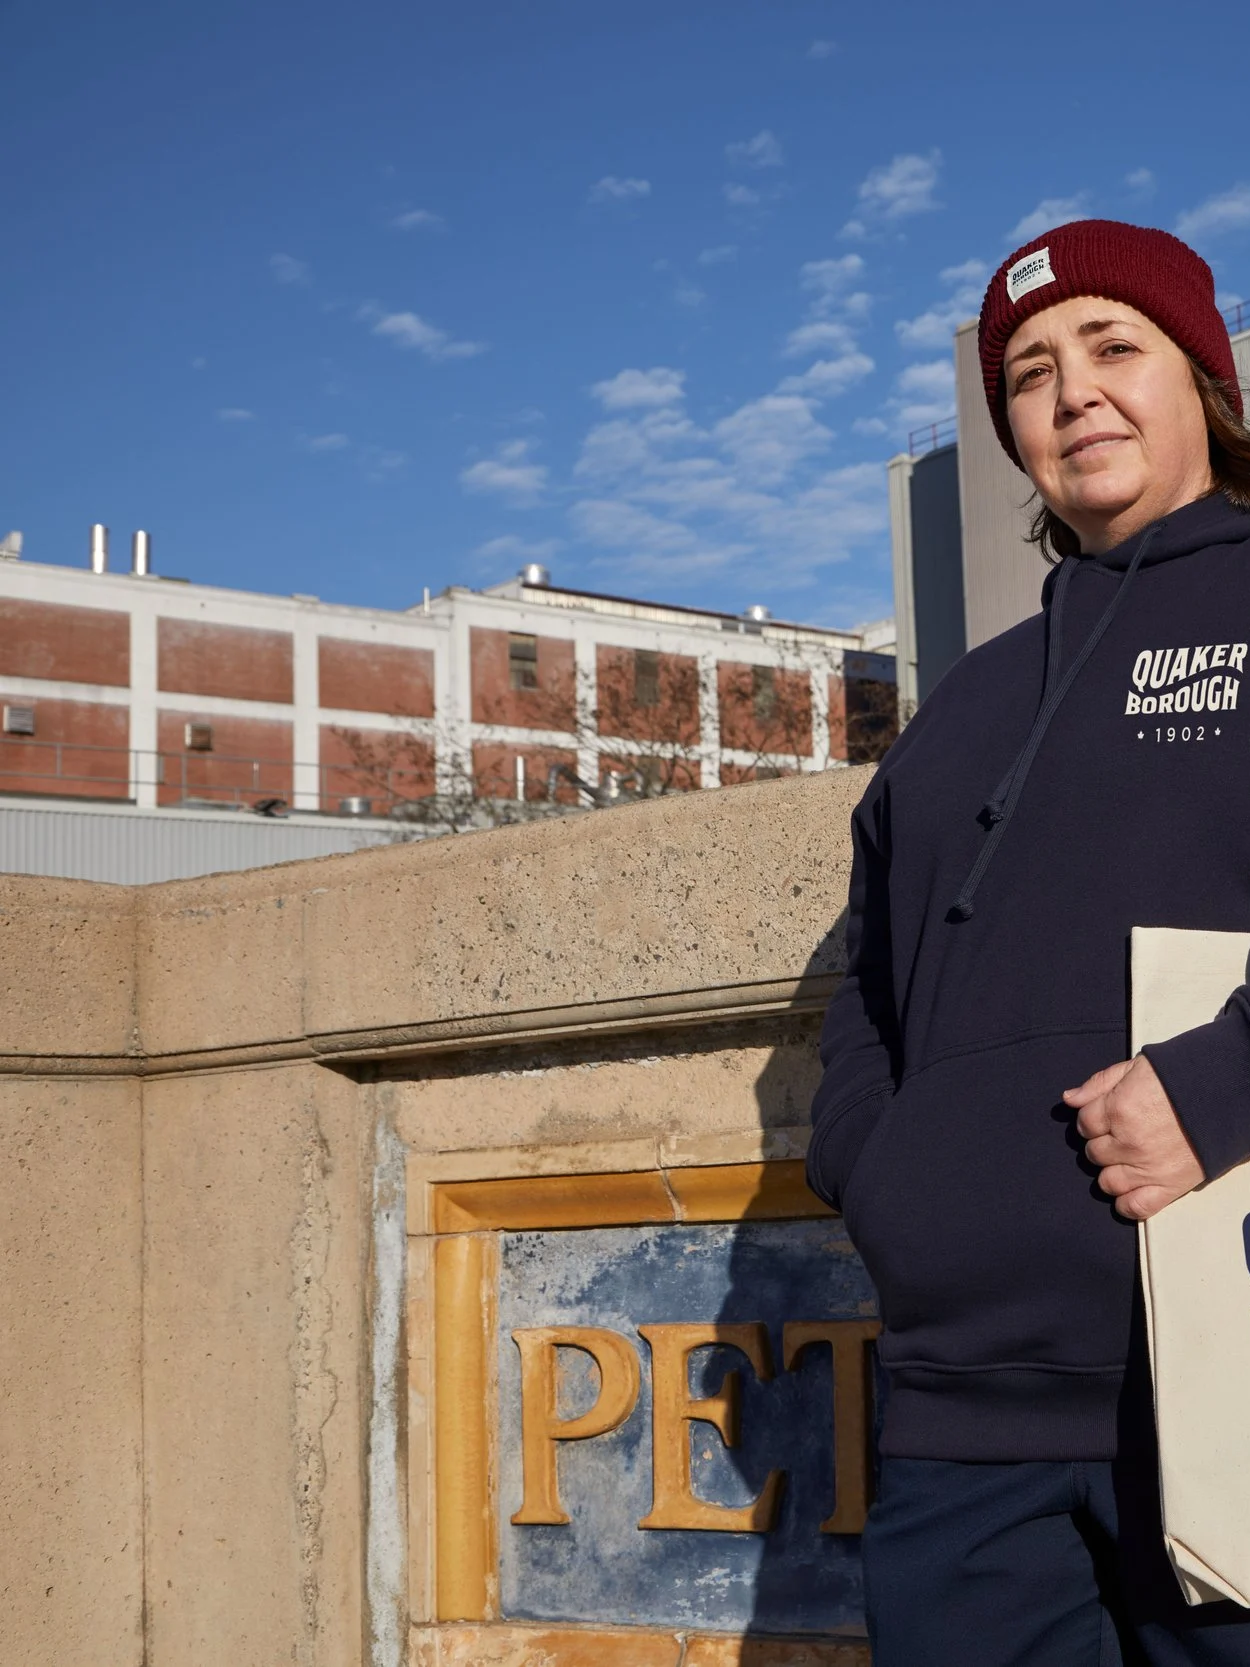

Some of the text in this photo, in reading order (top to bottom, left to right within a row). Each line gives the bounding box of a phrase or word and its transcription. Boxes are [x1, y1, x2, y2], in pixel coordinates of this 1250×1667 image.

[1012, 258, 1044, 281] QUAKER
[1132, 643, 1248, 693] QUAKER
[1124, 675, 1240, 715] BOROUGH
[1155, 726, 1205, 742] 1902
